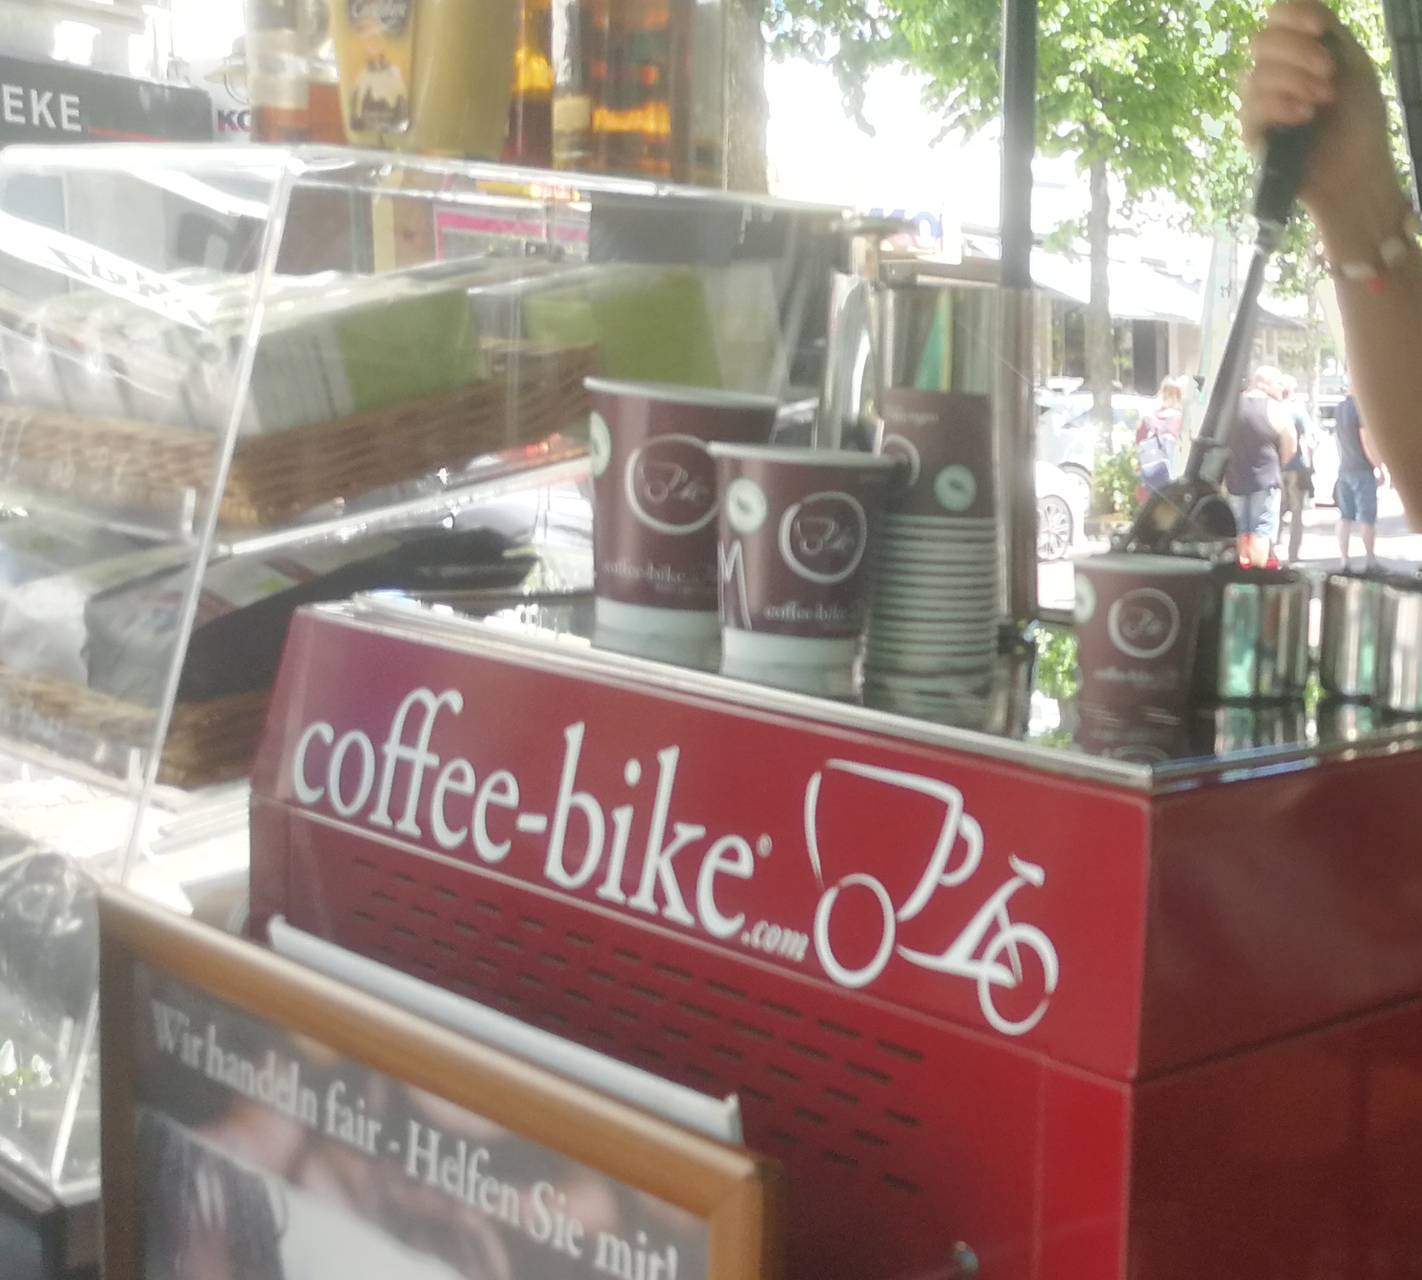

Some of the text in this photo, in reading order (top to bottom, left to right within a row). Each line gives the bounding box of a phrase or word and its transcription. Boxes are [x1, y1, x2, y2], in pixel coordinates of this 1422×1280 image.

[2, 84, 82, 132] EKE
[152, 1000, 204, 1070] Wir
[205, 1025, 318, 1127] handeln
[326, 1079, 382, 1156] fair
[406, 1119, 521, 1227] Helfen
[527, 1180, 586, 1259] Sie
